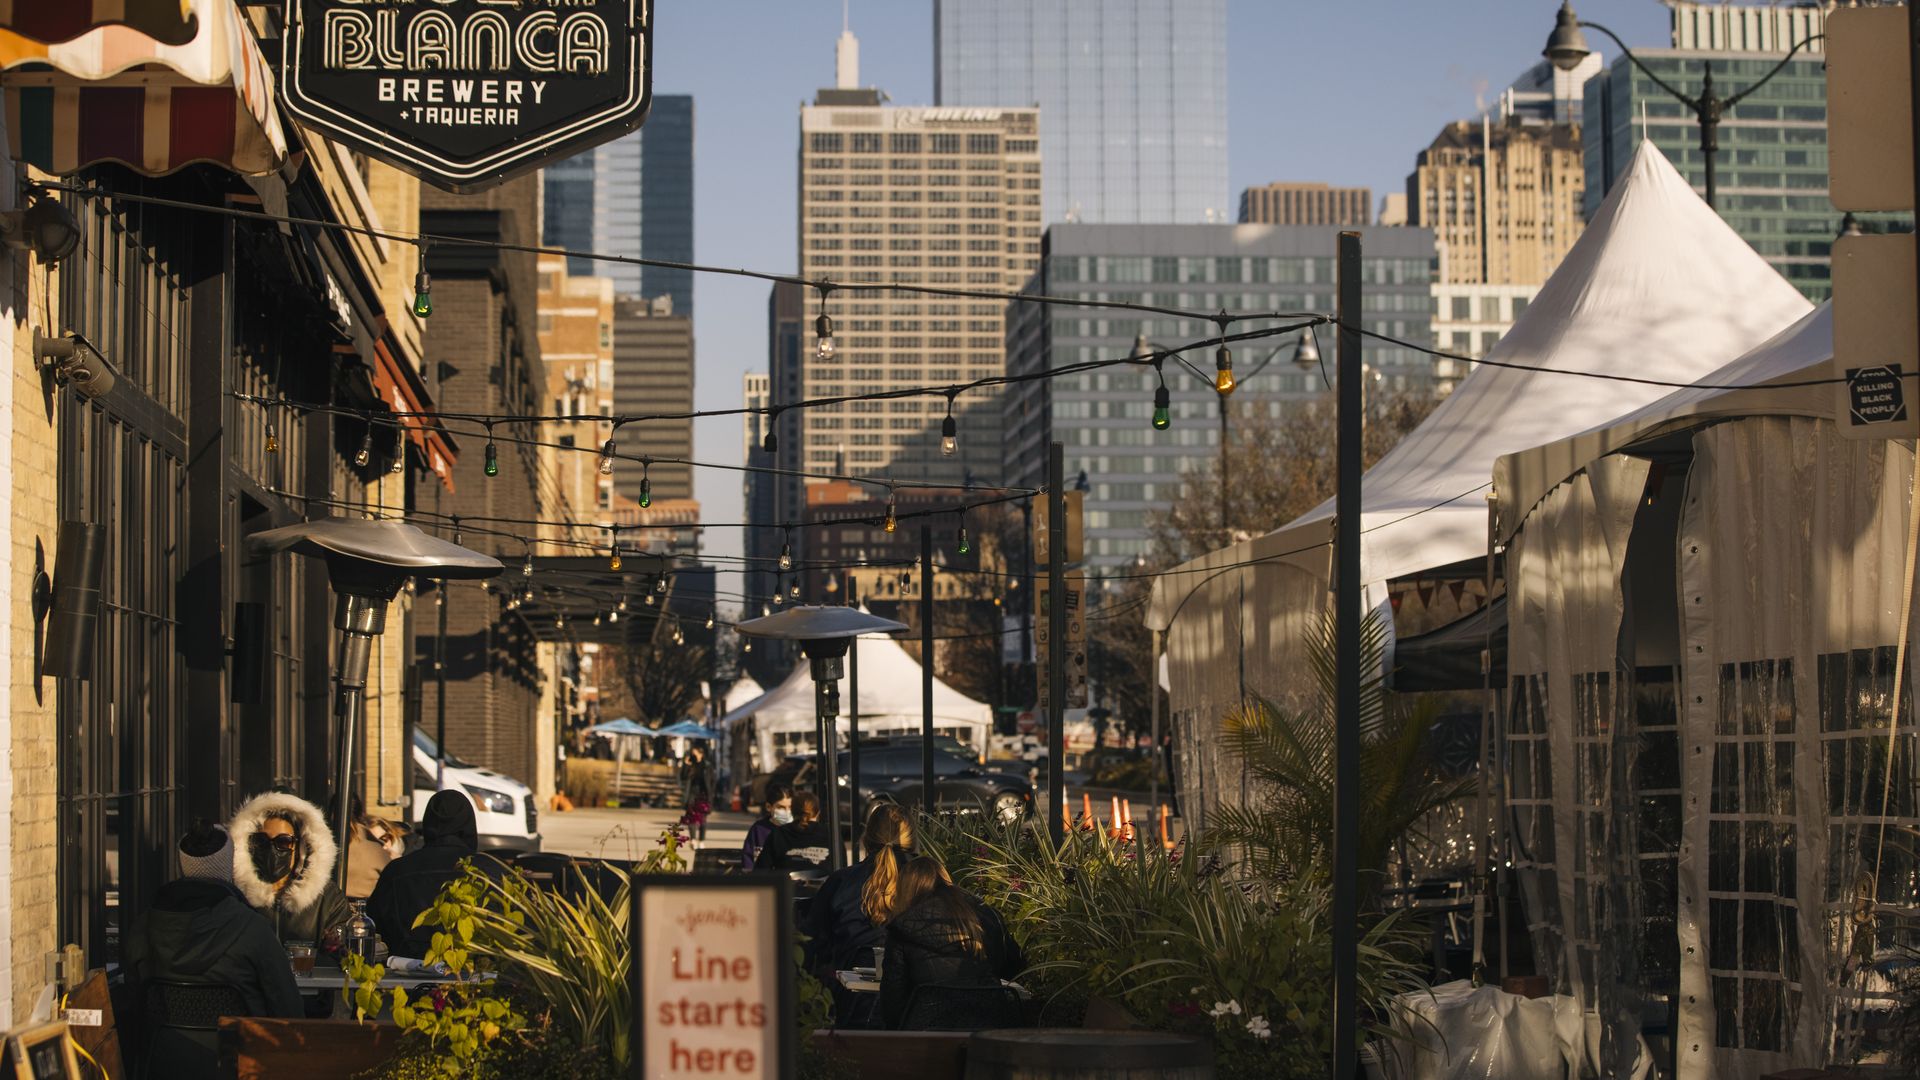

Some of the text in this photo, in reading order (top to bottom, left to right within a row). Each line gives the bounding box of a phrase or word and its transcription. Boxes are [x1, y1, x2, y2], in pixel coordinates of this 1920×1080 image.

[324, 9, 609, 73] BLANCA
[378, 78, 547, 104] BREWERY
[1857, 382, 1894, 392] KILLING
[1861, 394, 1892, 403] BLACK
[1860, 405, 1896, 415] PEOPLE
[672, 947, 752, 981] Line
[659, 997, 768, 1027] starts
[669, 1039, 755, 1073] here
